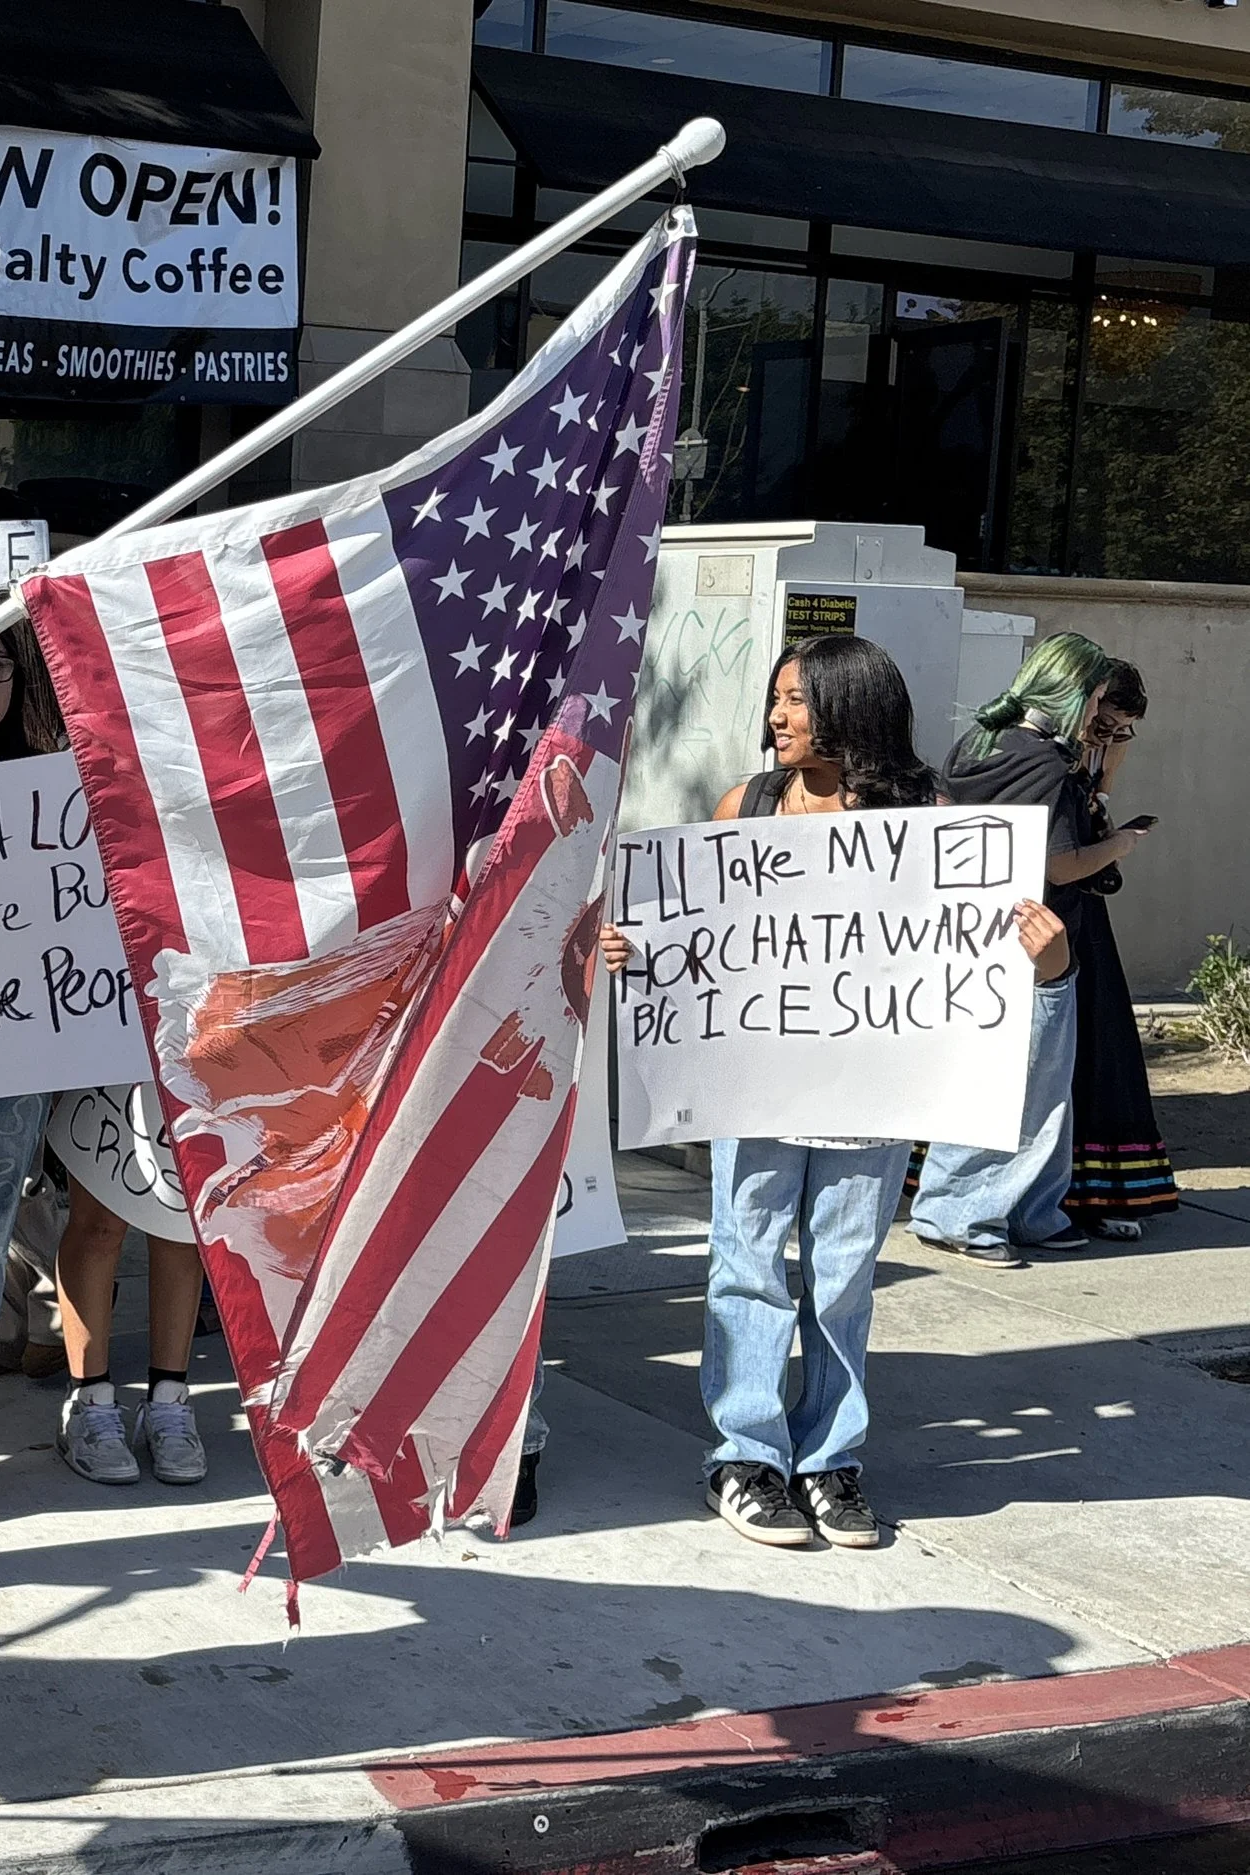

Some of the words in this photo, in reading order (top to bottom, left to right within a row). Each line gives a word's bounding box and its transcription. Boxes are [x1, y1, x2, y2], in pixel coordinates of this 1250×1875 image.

[79, 152, 281, 227] OPEN!
[122, 247, 285, 295] Coffee
[56, 344, 174, 383] SMOOTHIES
[194, 351, 289, 383] PASTRIES
[788, 596, 810, 608] Cash
[812, 598, 819, 608] 4
[820, 598, 855, 610] Diabetic
[788, 610, 811, 620] TEST
[813, 611, 846, 622] STRIPS
[615, 836, 706, 928] I'LL
[828, 819, 908, 882] MY
[696, 983, 821, 1040] ICE
[829, 963, 1007, 1038] SUCKS
